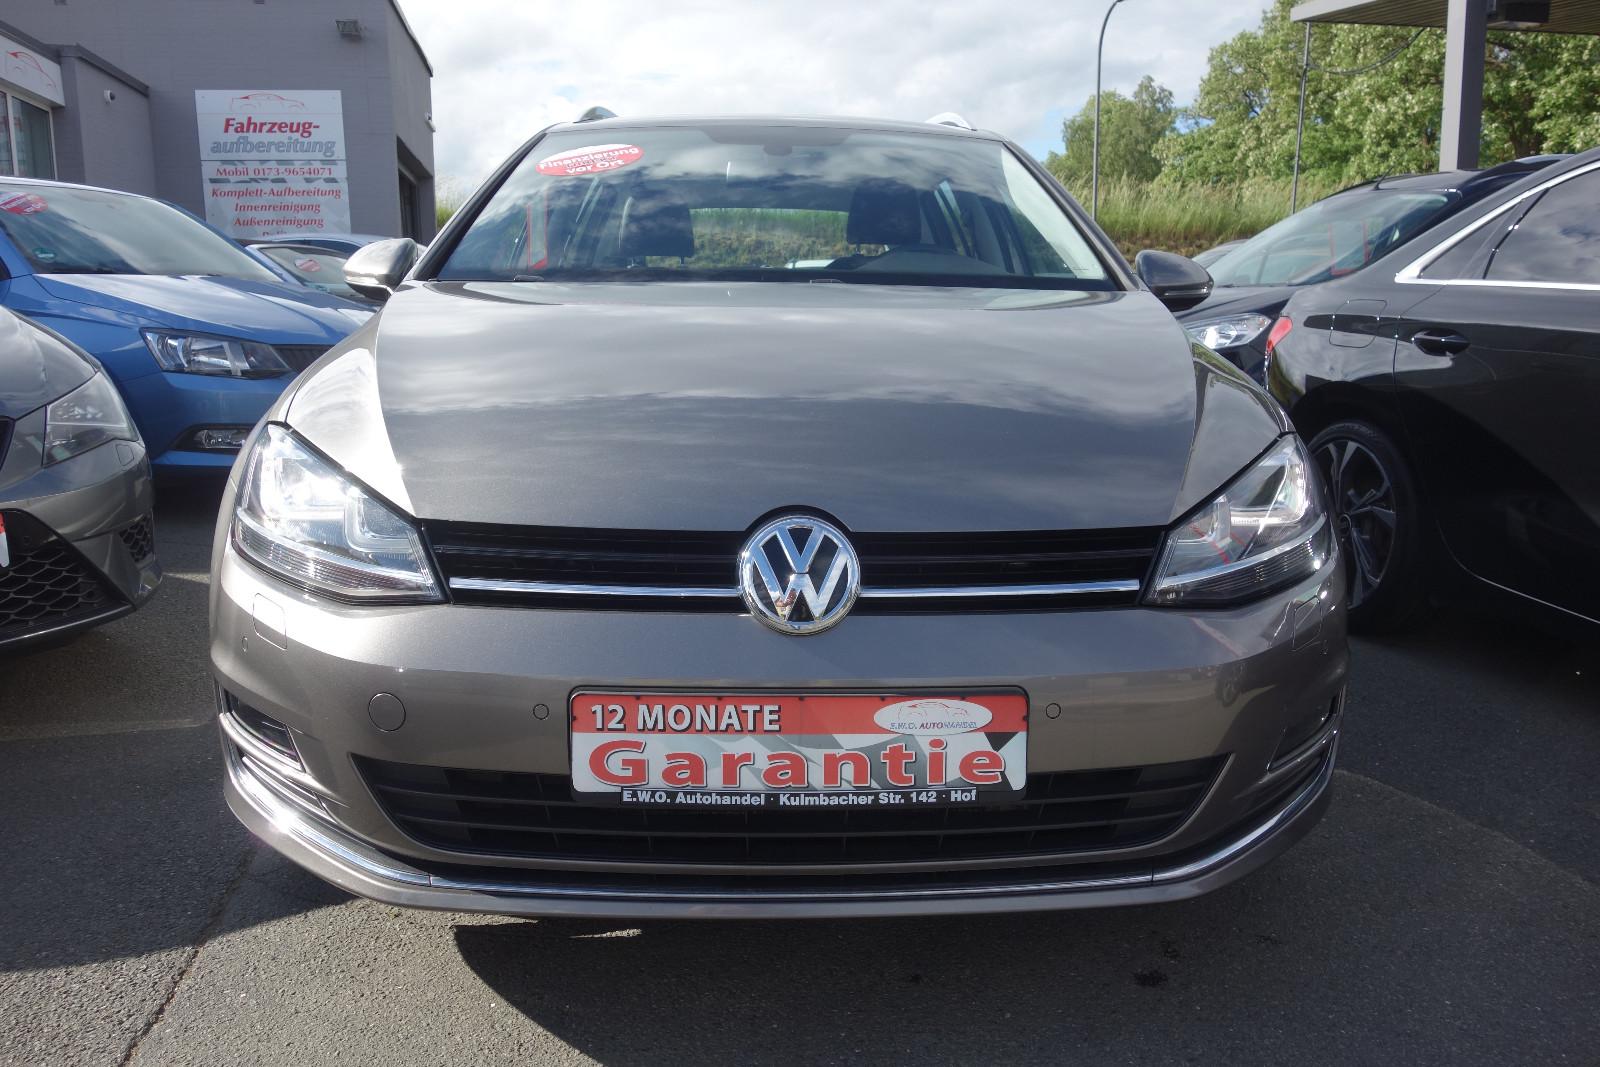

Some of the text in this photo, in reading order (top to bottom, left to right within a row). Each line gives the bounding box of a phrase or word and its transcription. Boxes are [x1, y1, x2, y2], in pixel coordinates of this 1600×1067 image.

[223, 116, 320, 138] Fahrzeug-
[210, 136, 337, 158] aufbereitung
[539, 147, 639, 169] Finanzierung
[566, 163, 593, 174] vor
[596, 159, 625, 169] Ort
[216, 166, 333, 177] Mobil 0173-9654071
[211, 186, 343, 200] Komplett-Aufbereitung
[234, 202, 321, 214] Innenreinigung
[233, 216, 324, 228] Außenreinigung
[744, 519, 856, 628] VW
[591, 704, 781, 732] 12 MONATE
[889, 721, 917, 730] E.W.O.
[588, 737, 1007, 788] Garantie
[622, 788, 977, 806] E.W.O. Autohandel Kulmbacher Str. 142 Hof
